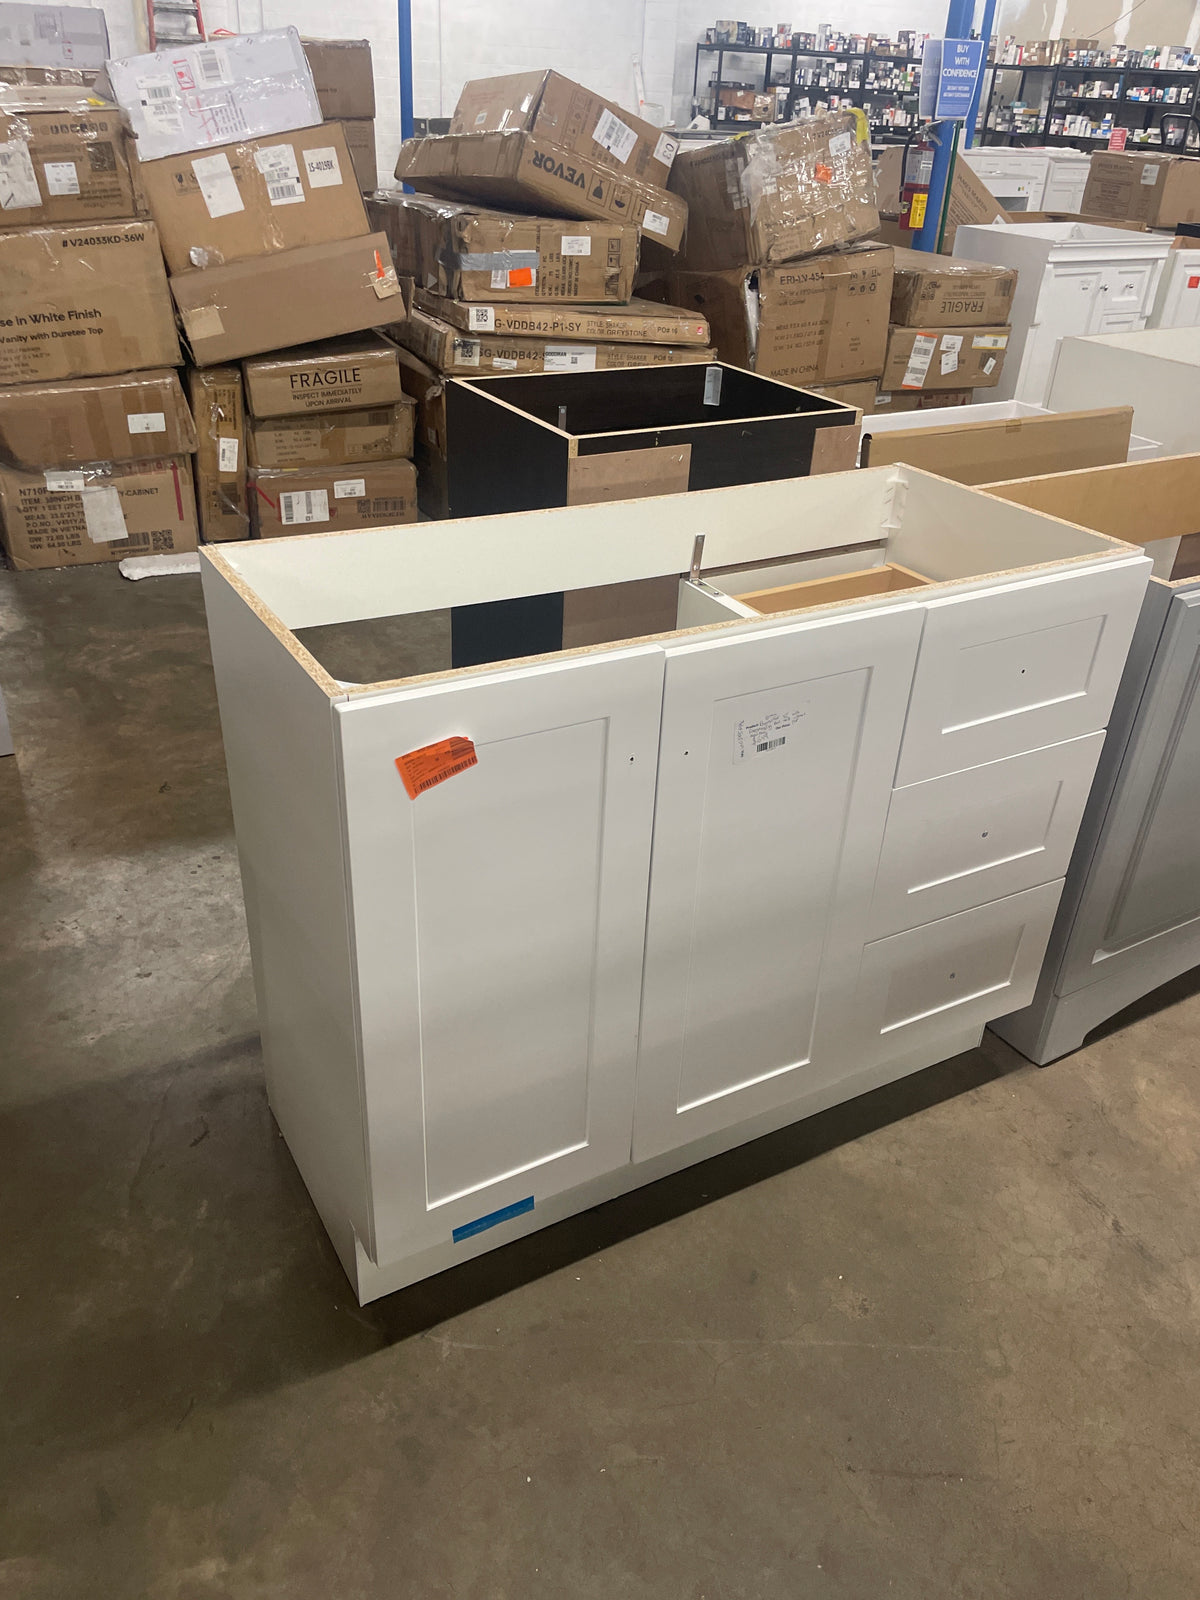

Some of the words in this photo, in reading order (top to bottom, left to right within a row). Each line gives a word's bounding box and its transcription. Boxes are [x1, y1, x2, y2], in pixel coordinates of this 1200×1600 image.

[957, 45, 969, 53] BUY
[955, 56, 970, 65] WITH
[943, 68, 977, 78] CONFIDENCE
[532, 150, 585, 189] VEVOR
[69, 233, 145, 247] V24033KD-36W
[940, 301, 984, 313] FRAGILE
[28, 312, 65, 324] White
[67, 309, 102, 320] Finish
[30, 330, 50, 340] with
[87, 327, 103, 336] Top
[289, 368, 361, 389] FRAGILE
[292, 392, 319, 401] INSPECT
[321, 387, 362, 397] IMMEDIATELY
[305, 399, 325, 407] UPON
[326, 397, 352, 405] ARRIVAL
[60, 525, 86, 533] VIETNA
